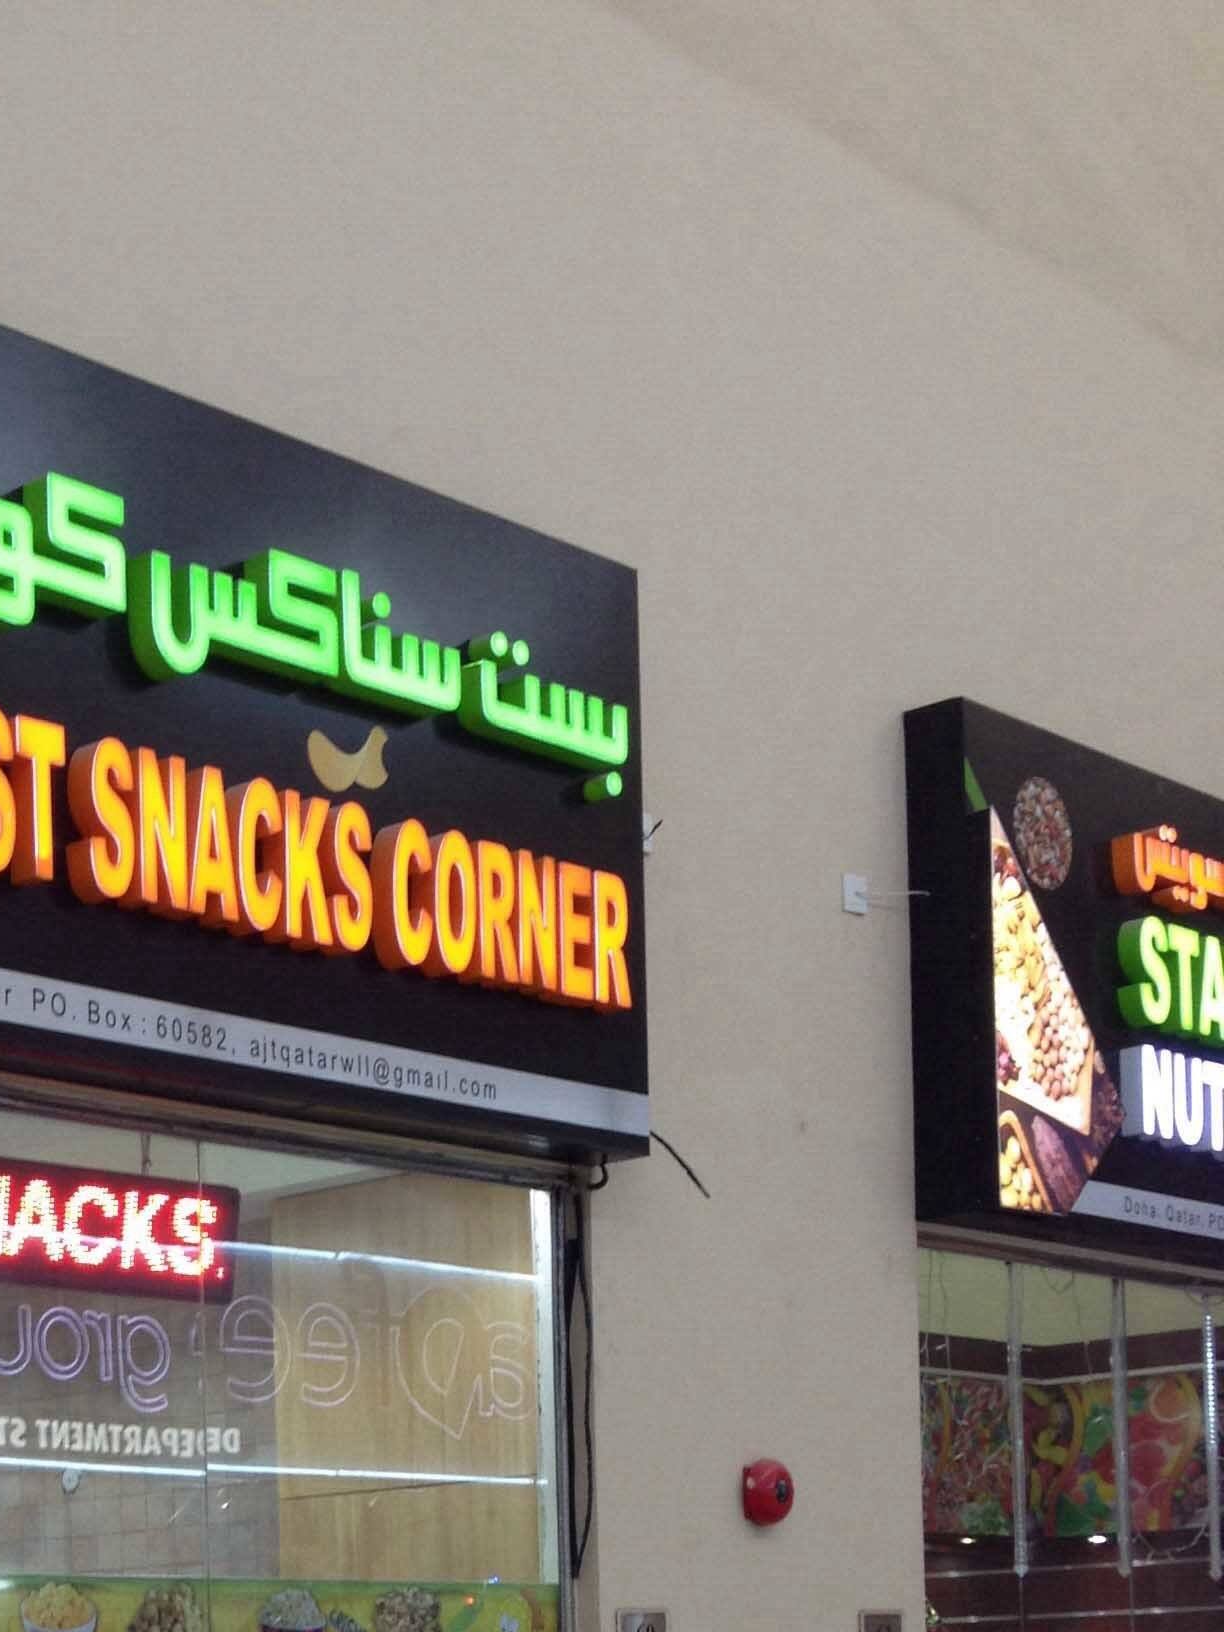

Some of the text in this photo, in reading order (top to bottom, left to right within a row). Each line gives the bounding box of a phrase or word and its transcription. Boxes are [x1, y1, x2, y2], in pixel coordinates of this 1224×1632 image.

[142, 548, 462, 711] سناكس
[474, 631, 628, 798] بست
[78, 737, 373, 954] SNACKS
[384, 819, 633, 1009] CORNER
